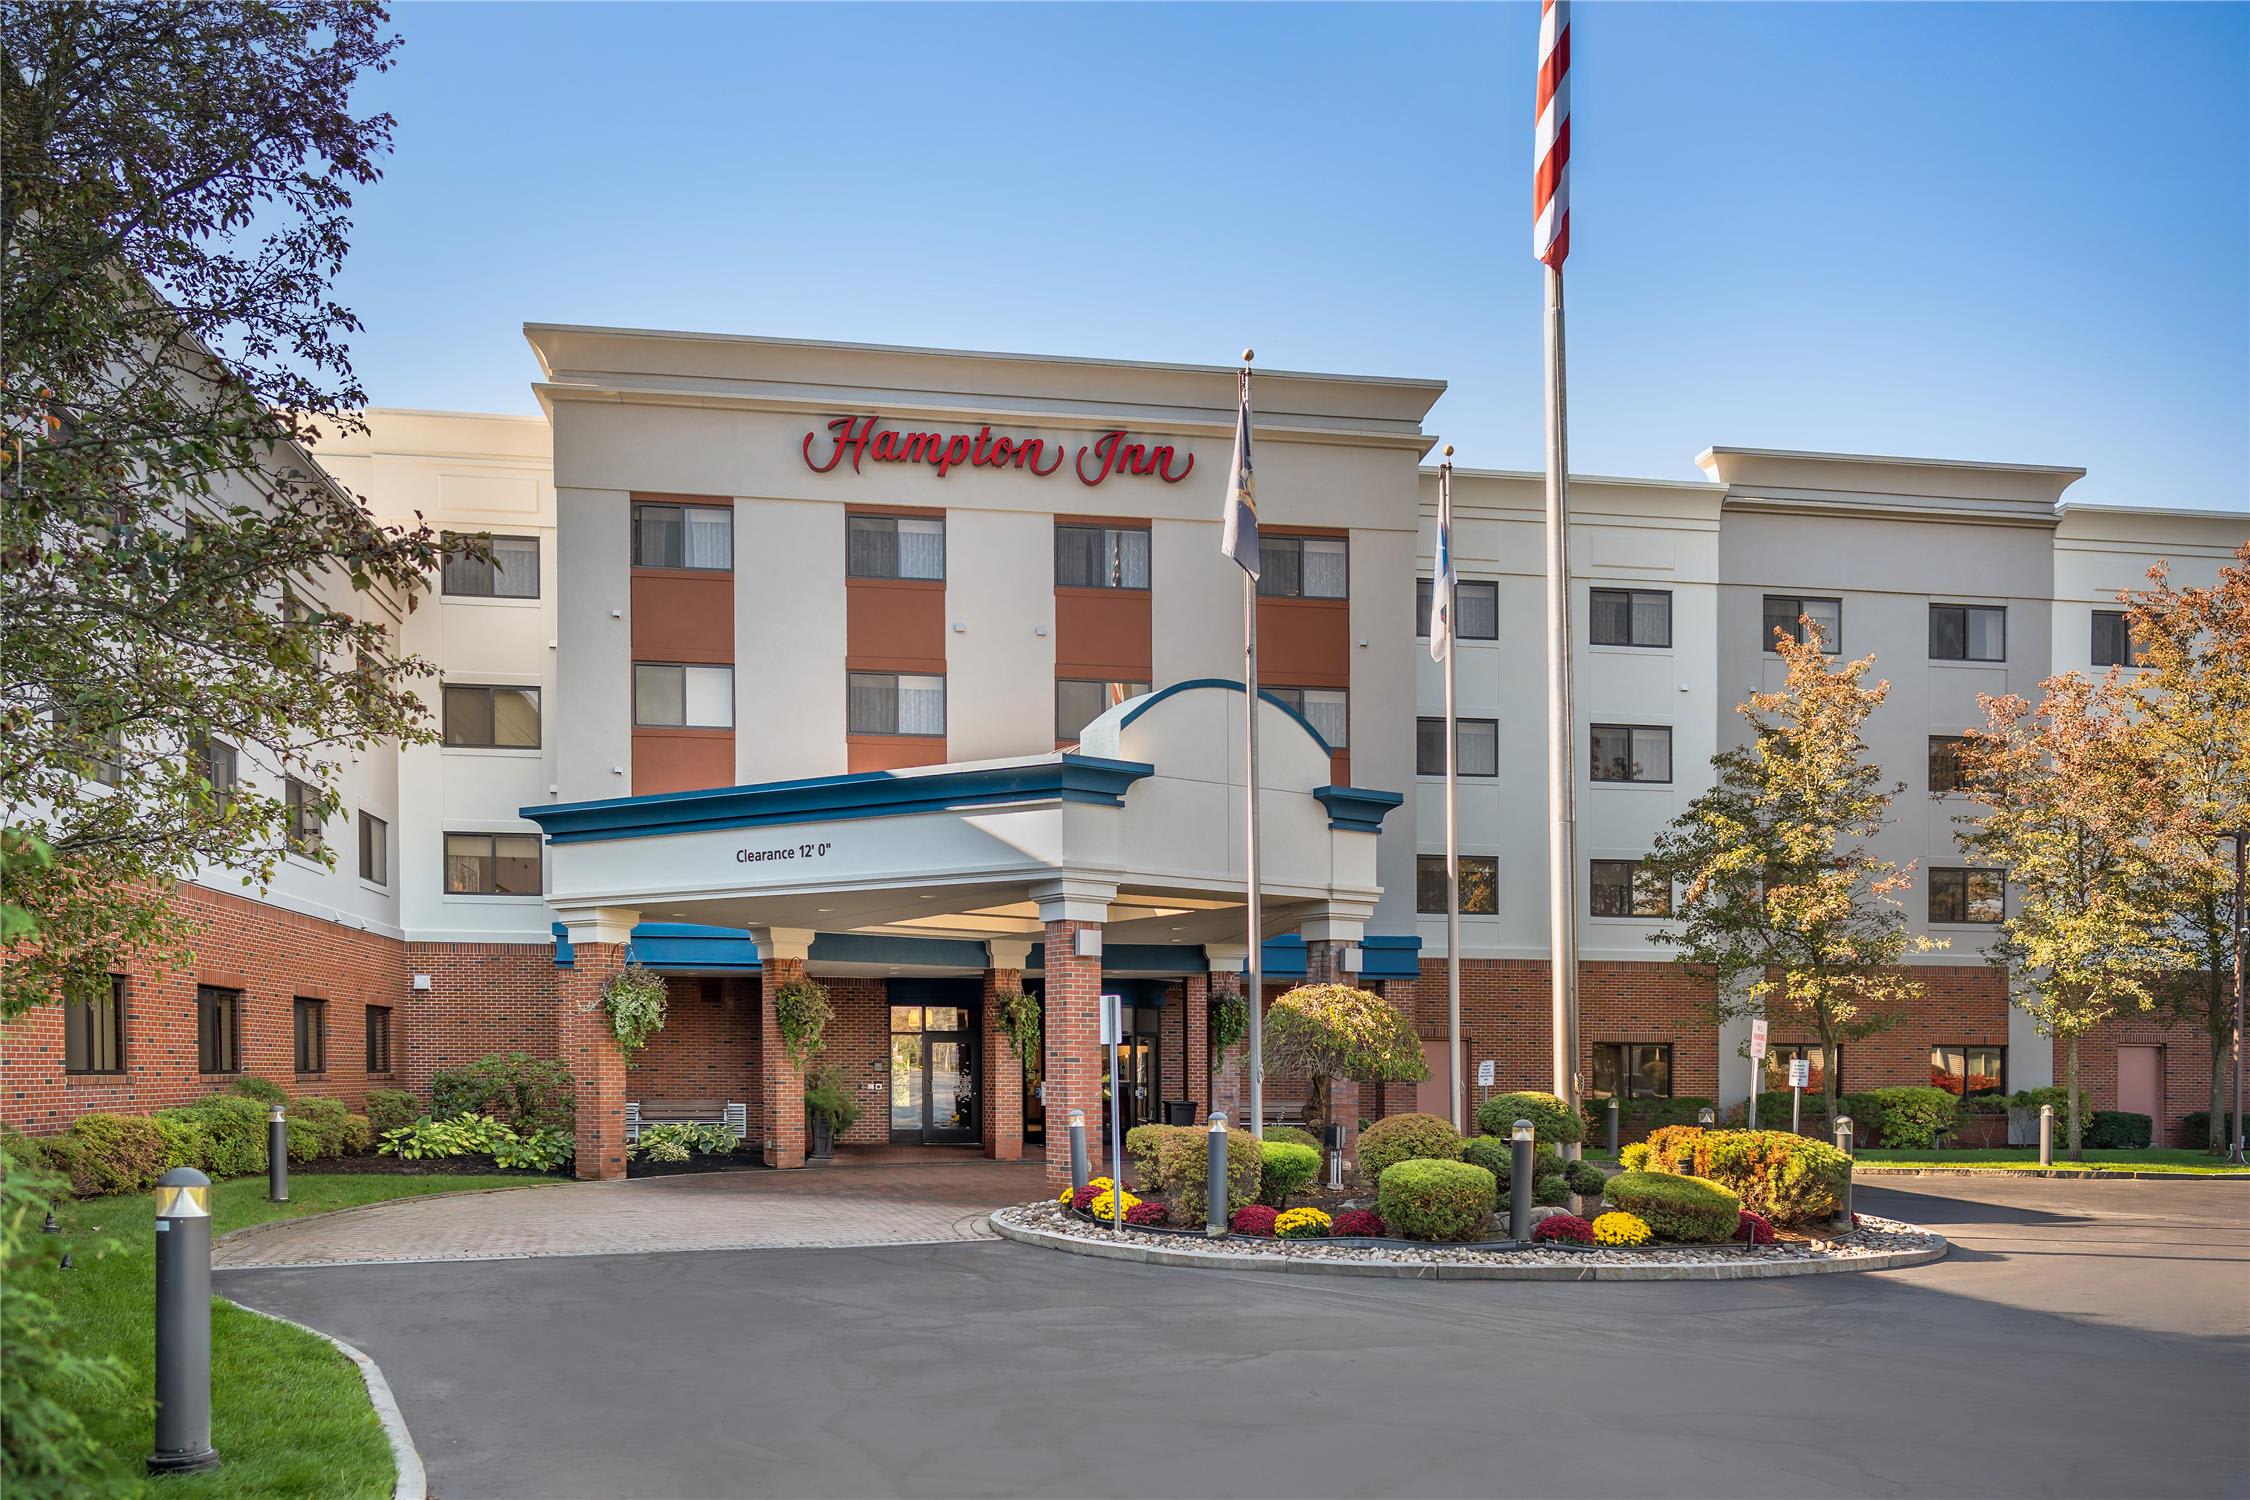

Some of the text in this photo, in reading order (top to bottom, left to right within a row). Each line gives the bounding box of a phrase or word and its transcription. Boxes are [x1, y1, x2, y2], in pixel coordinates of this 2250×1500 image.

[802, 415, 1195, 487] Hampton Inn
[736, 842, 832, 863] Clearance 12' 0"
